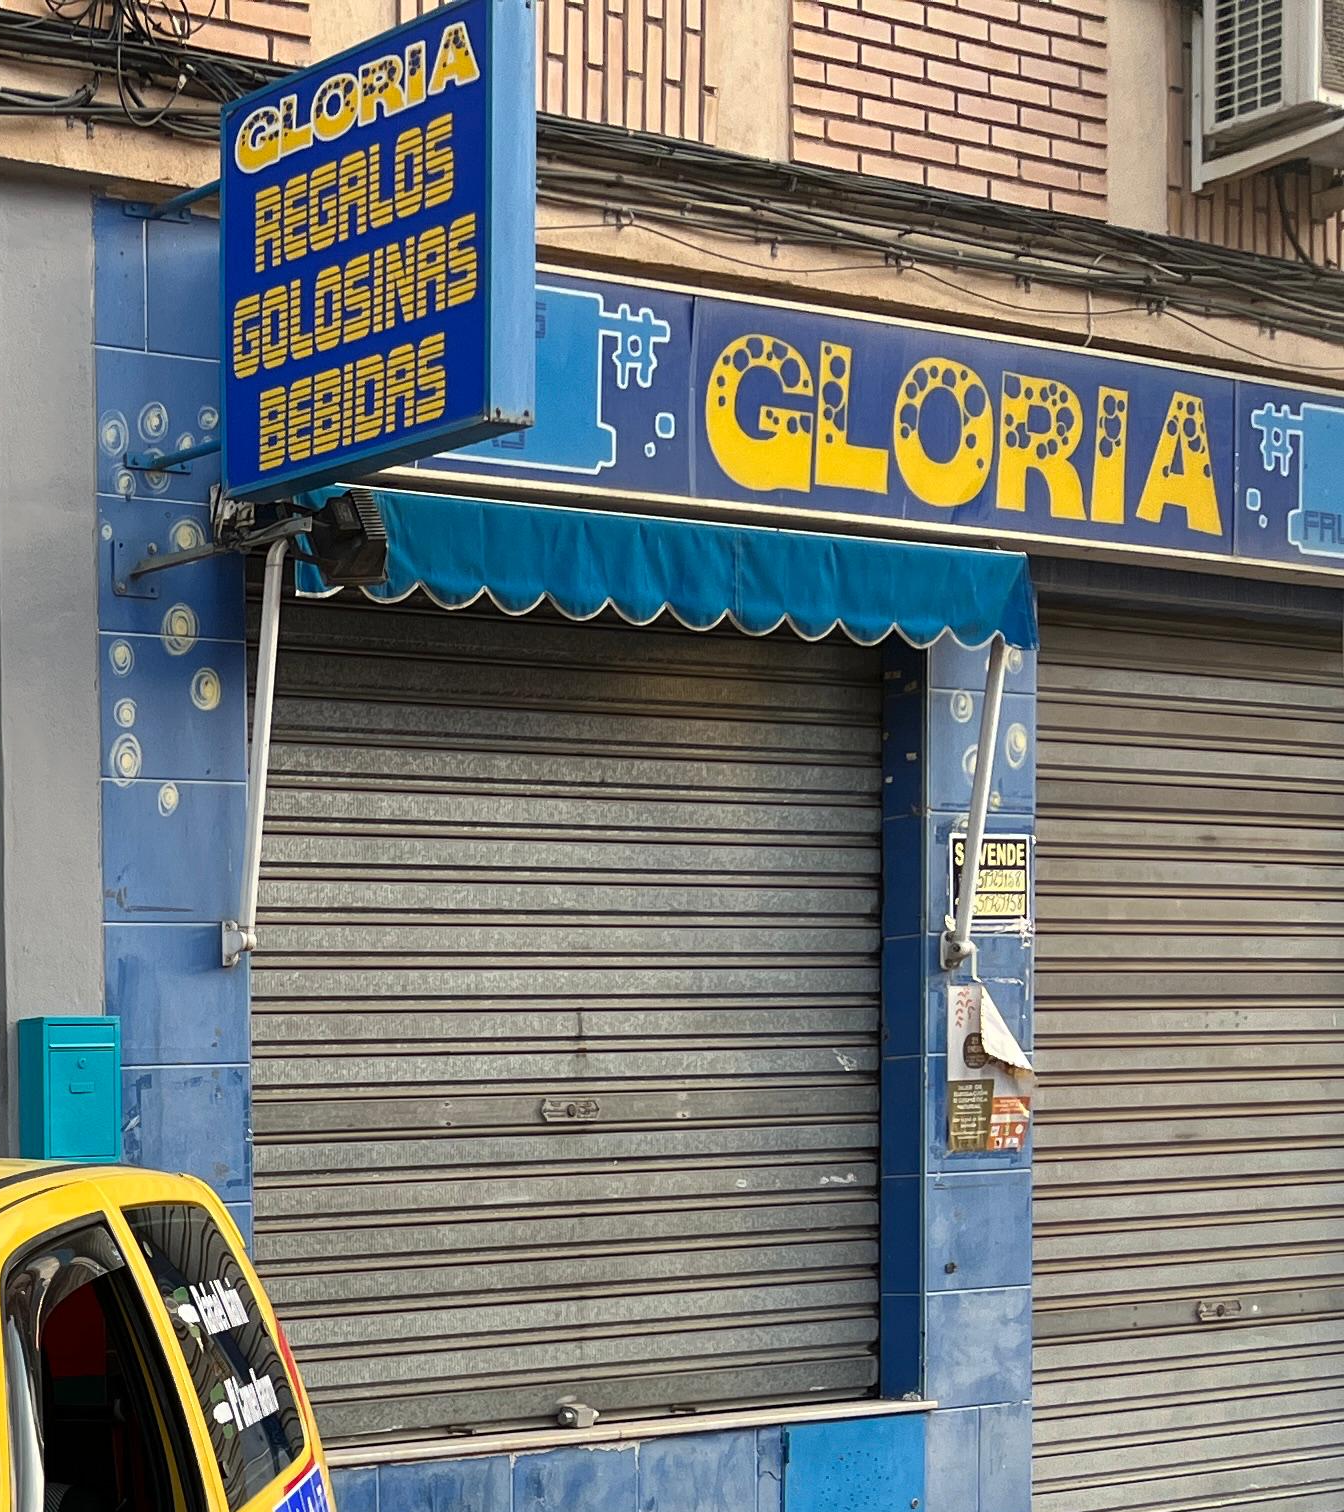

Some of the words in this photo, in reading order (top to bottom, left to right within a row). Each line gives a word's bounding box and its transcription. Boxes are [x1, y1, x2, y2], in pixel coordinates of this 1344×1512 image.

[234, 20, 480, 174] GLORIA
[254, 111, 454, 274] REGALOS
[232, 212, 477, 380] GOLOSINAS
[258, 332, 446, 472] BEBIDAS
[705, 332, 1224, 537] GLORIA
